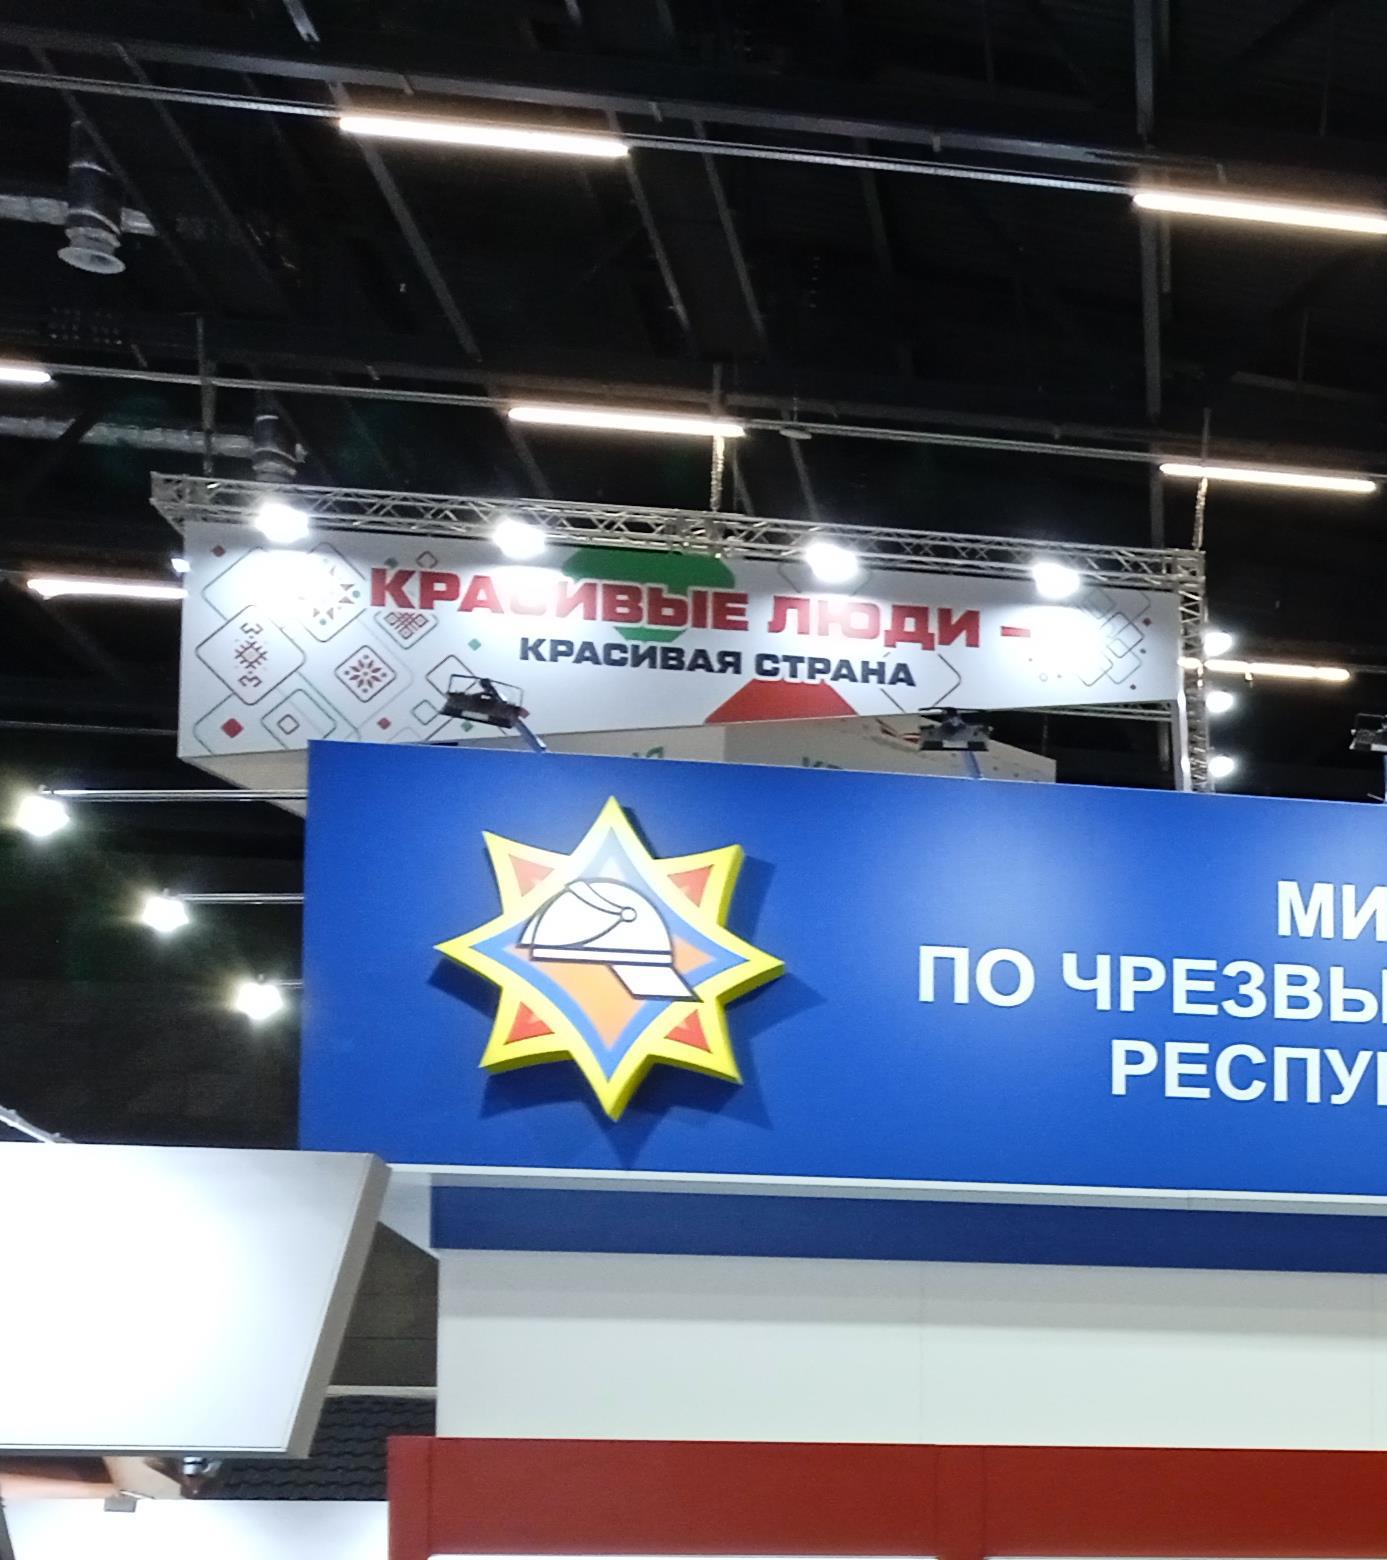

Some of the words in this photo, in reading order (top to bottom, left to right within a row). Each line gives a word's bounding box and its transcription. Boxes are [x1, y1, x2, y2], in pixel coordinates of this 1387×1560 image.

[370, 567, 749, 631] КРАСИВЫЕ
[768, 595, 981, 651] ЛЮДИ
[520, 637, 742, 675] КРАСИВАЯ
[754, 653, 917, 687] СТРАНА
[917, 943, 1034, 1008] ПО
